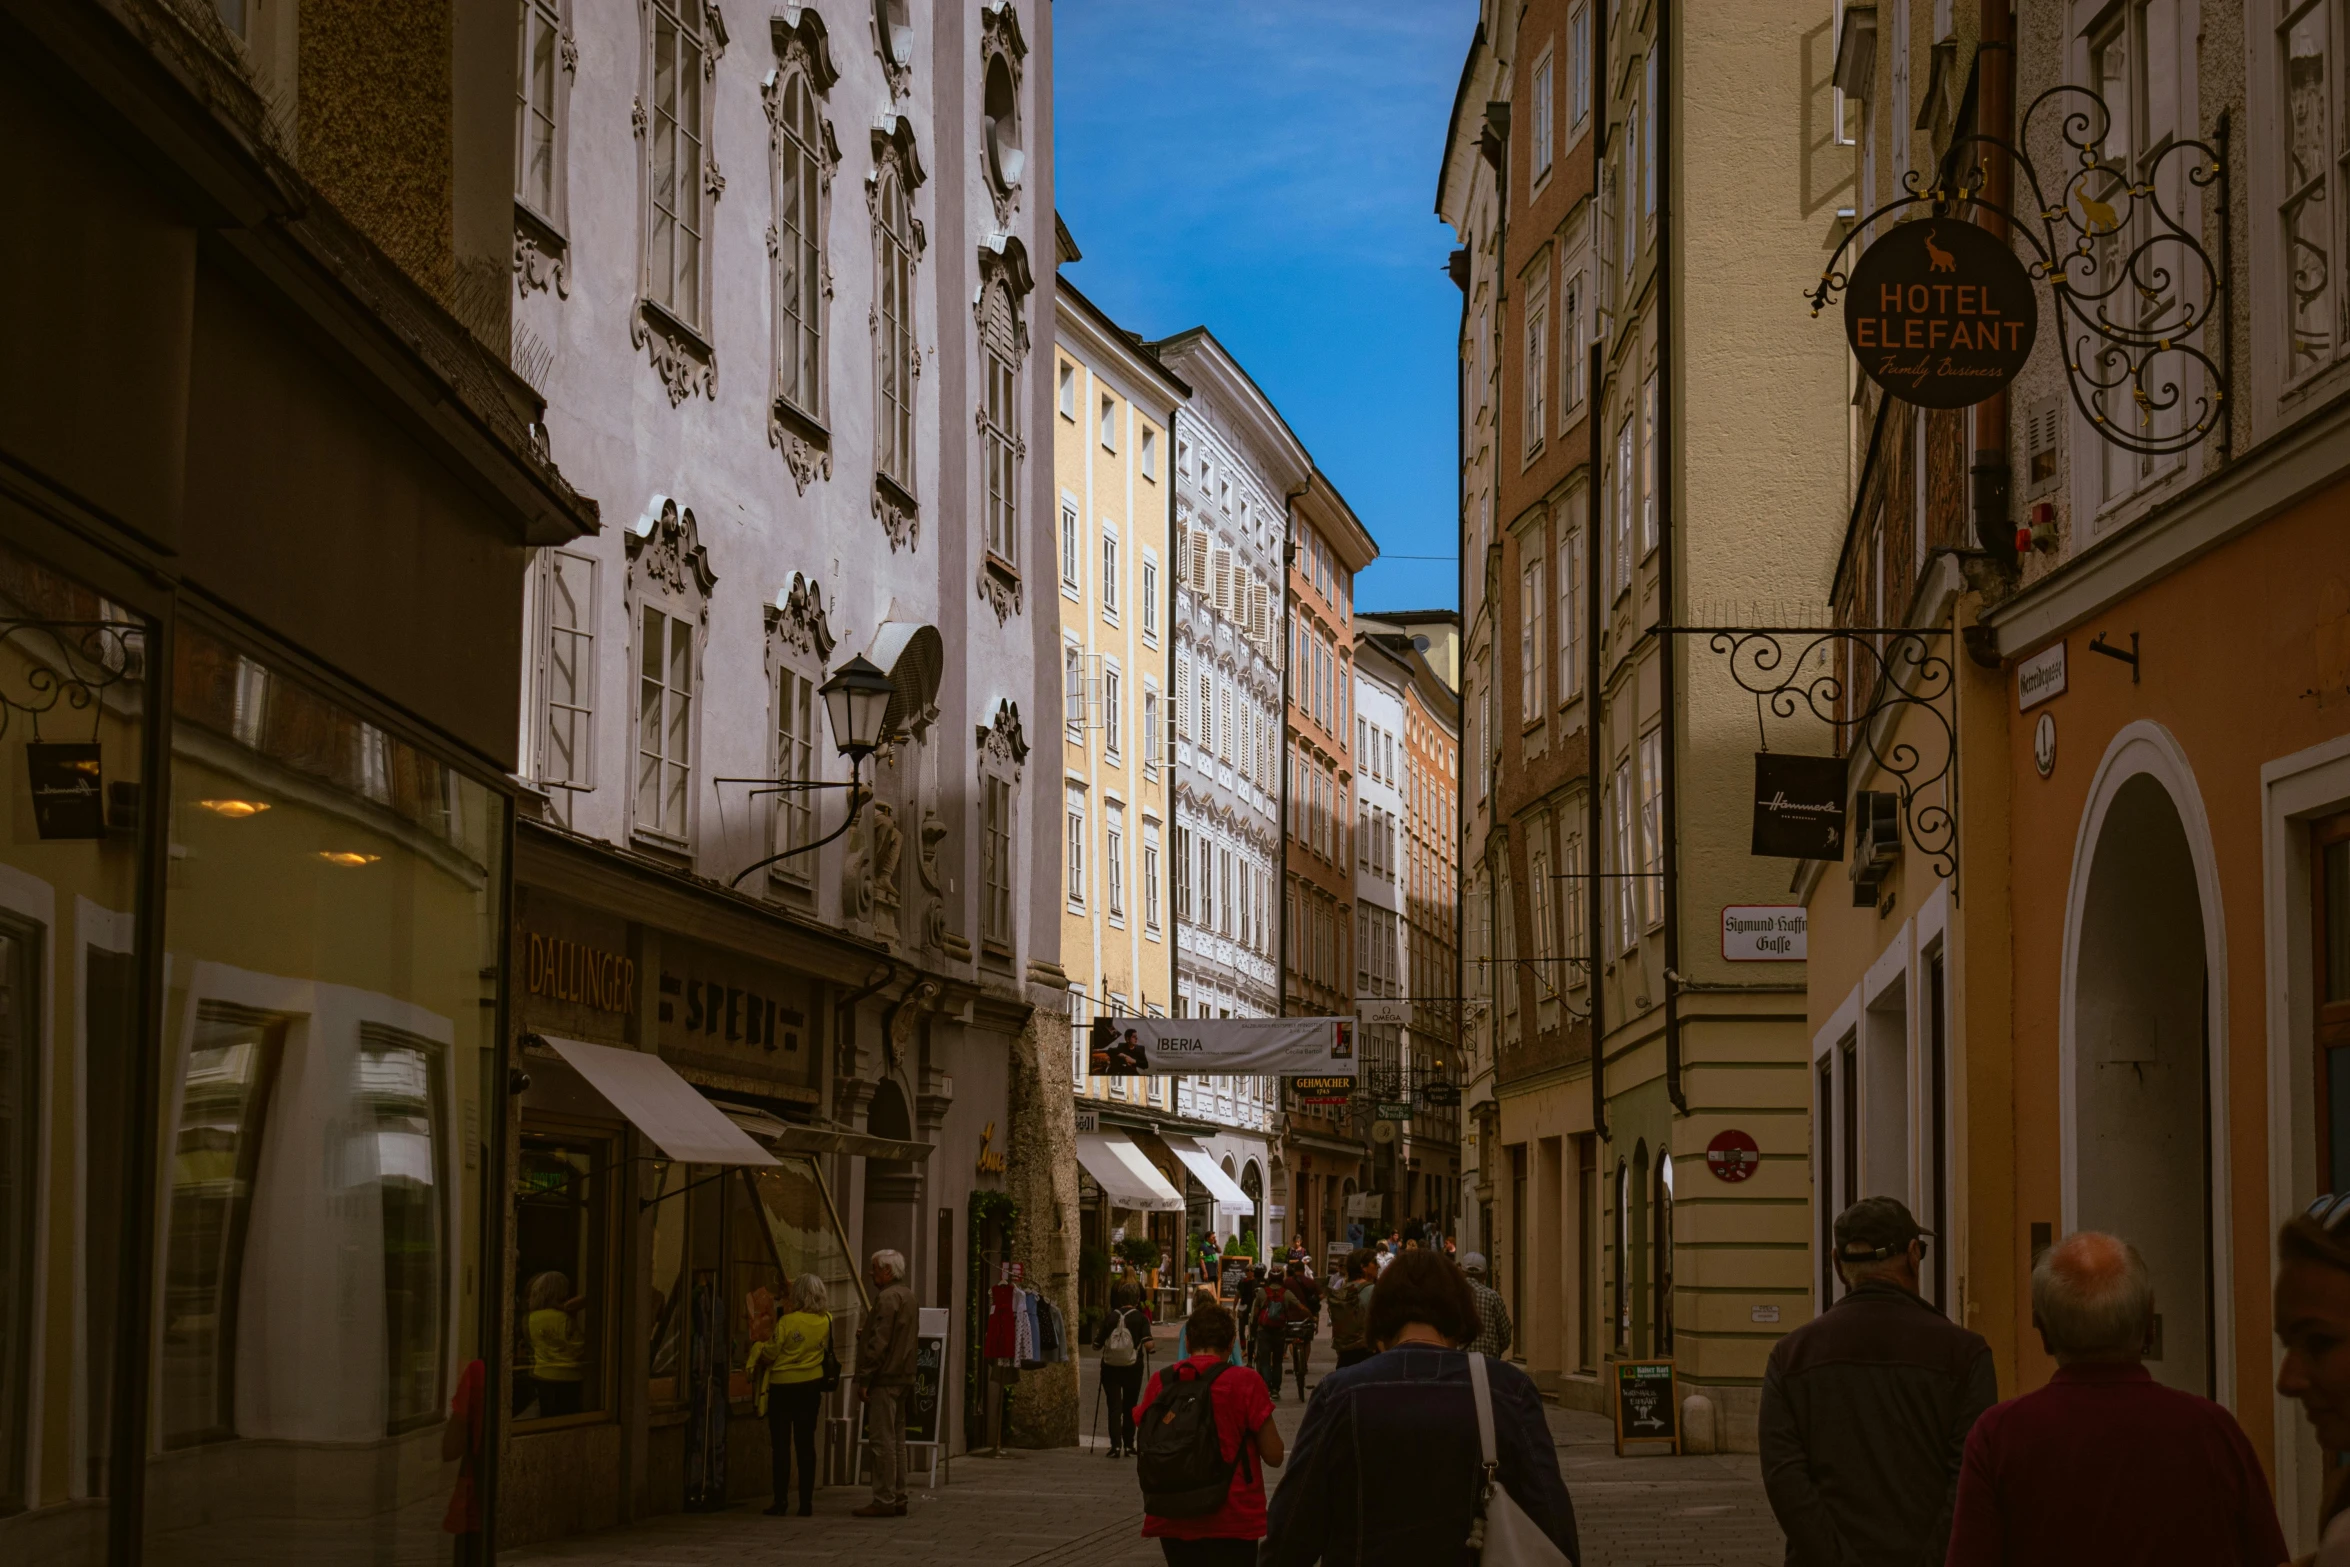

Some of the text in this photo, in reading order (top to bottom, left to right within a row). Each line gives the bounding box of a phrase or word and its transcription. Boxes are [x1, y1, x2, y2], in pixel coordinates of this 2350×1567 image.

[1880, 283, 2001, 316] HOTEL
[1857, 318, 2025, 351] ELEFANT
[1878, 354, 2003, 389] Family Business
[1758, 791, 1842, 813] Hämmerle
[529, 932, 634, 1014] DALLINGER
[1156, 1038, 1203, 1051] IBERIA
[1296, 1077, 1350, 1089] GEHMACHER
